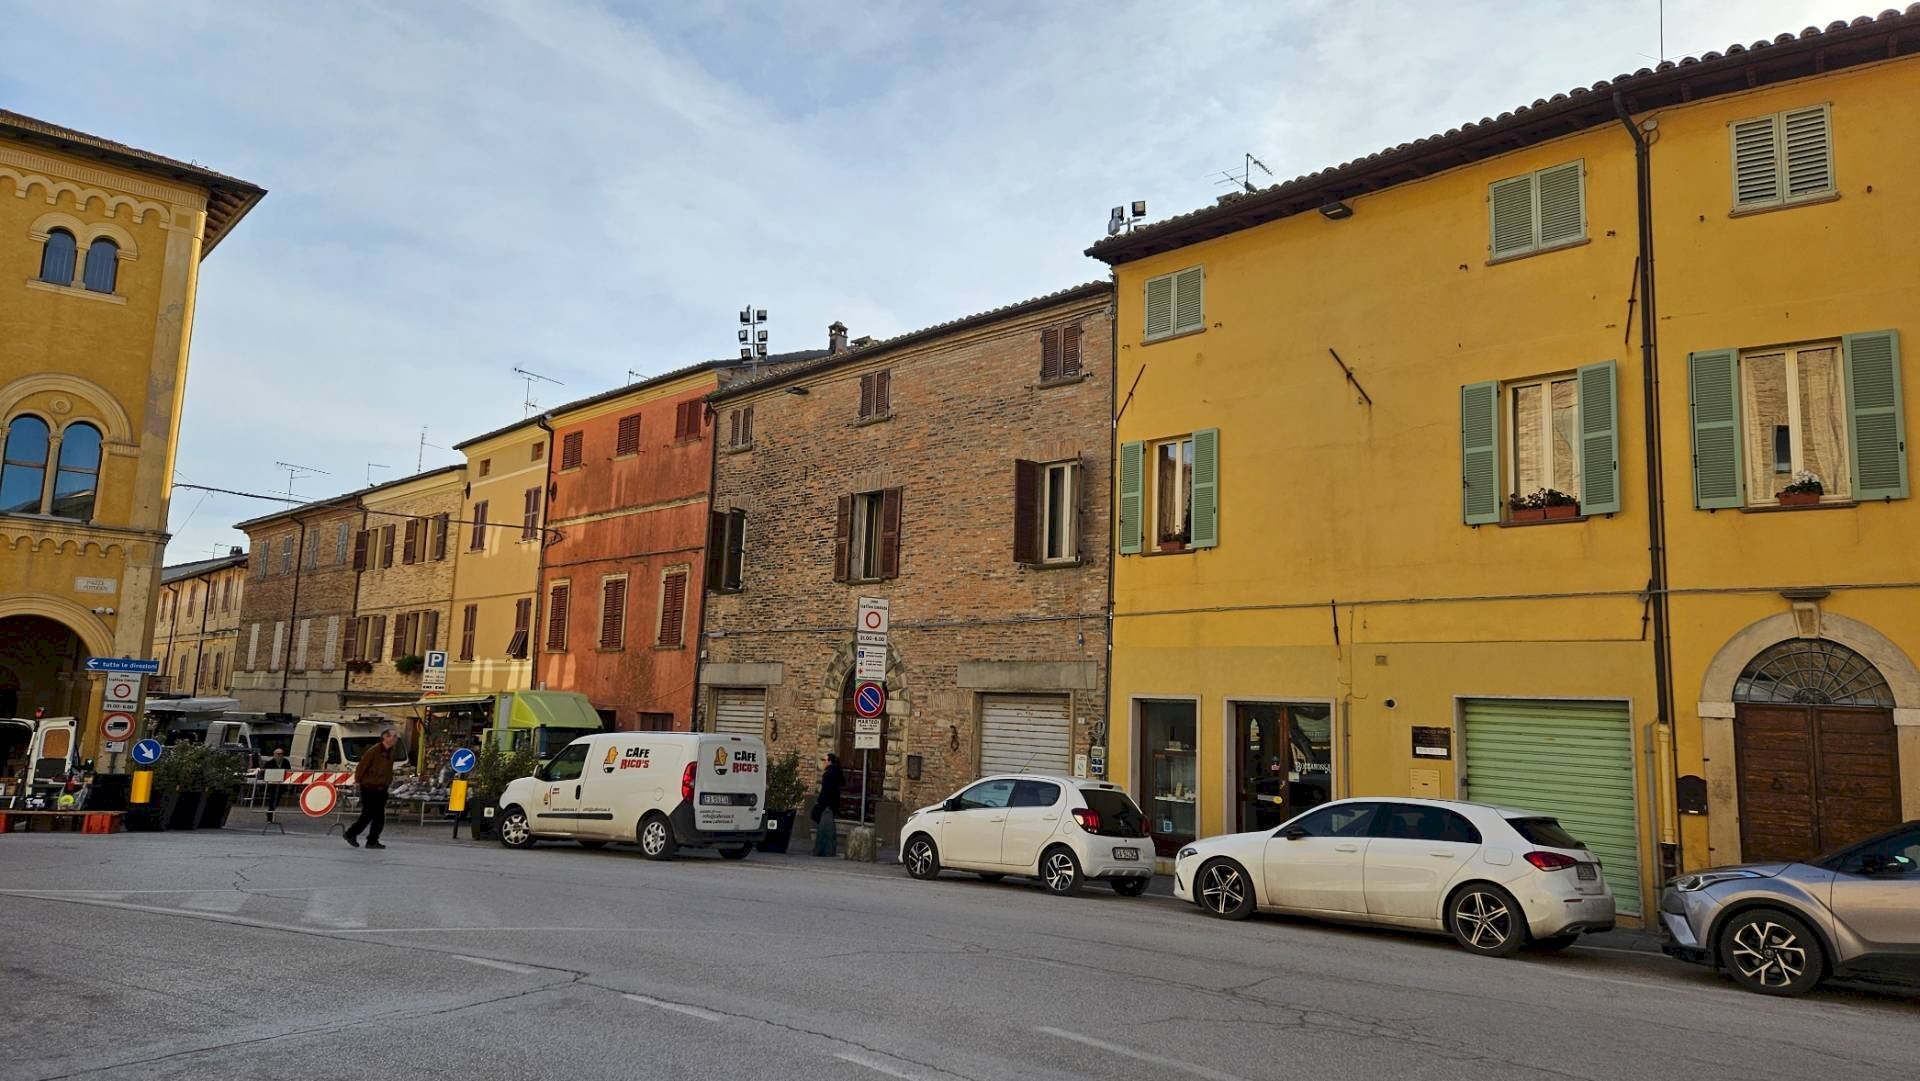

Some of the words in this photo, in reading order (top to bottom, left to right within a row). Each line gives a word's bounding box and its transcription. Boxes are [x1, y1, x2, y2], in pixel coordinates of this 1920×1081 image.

[430, 653, 443, 667] P
[625, 747, 650, 758] CAFE
[734, 750, 757, 762] CAFE
[619, 759, 650, 769] RICO'S
[732, 762, 759, 773] RICO'S
